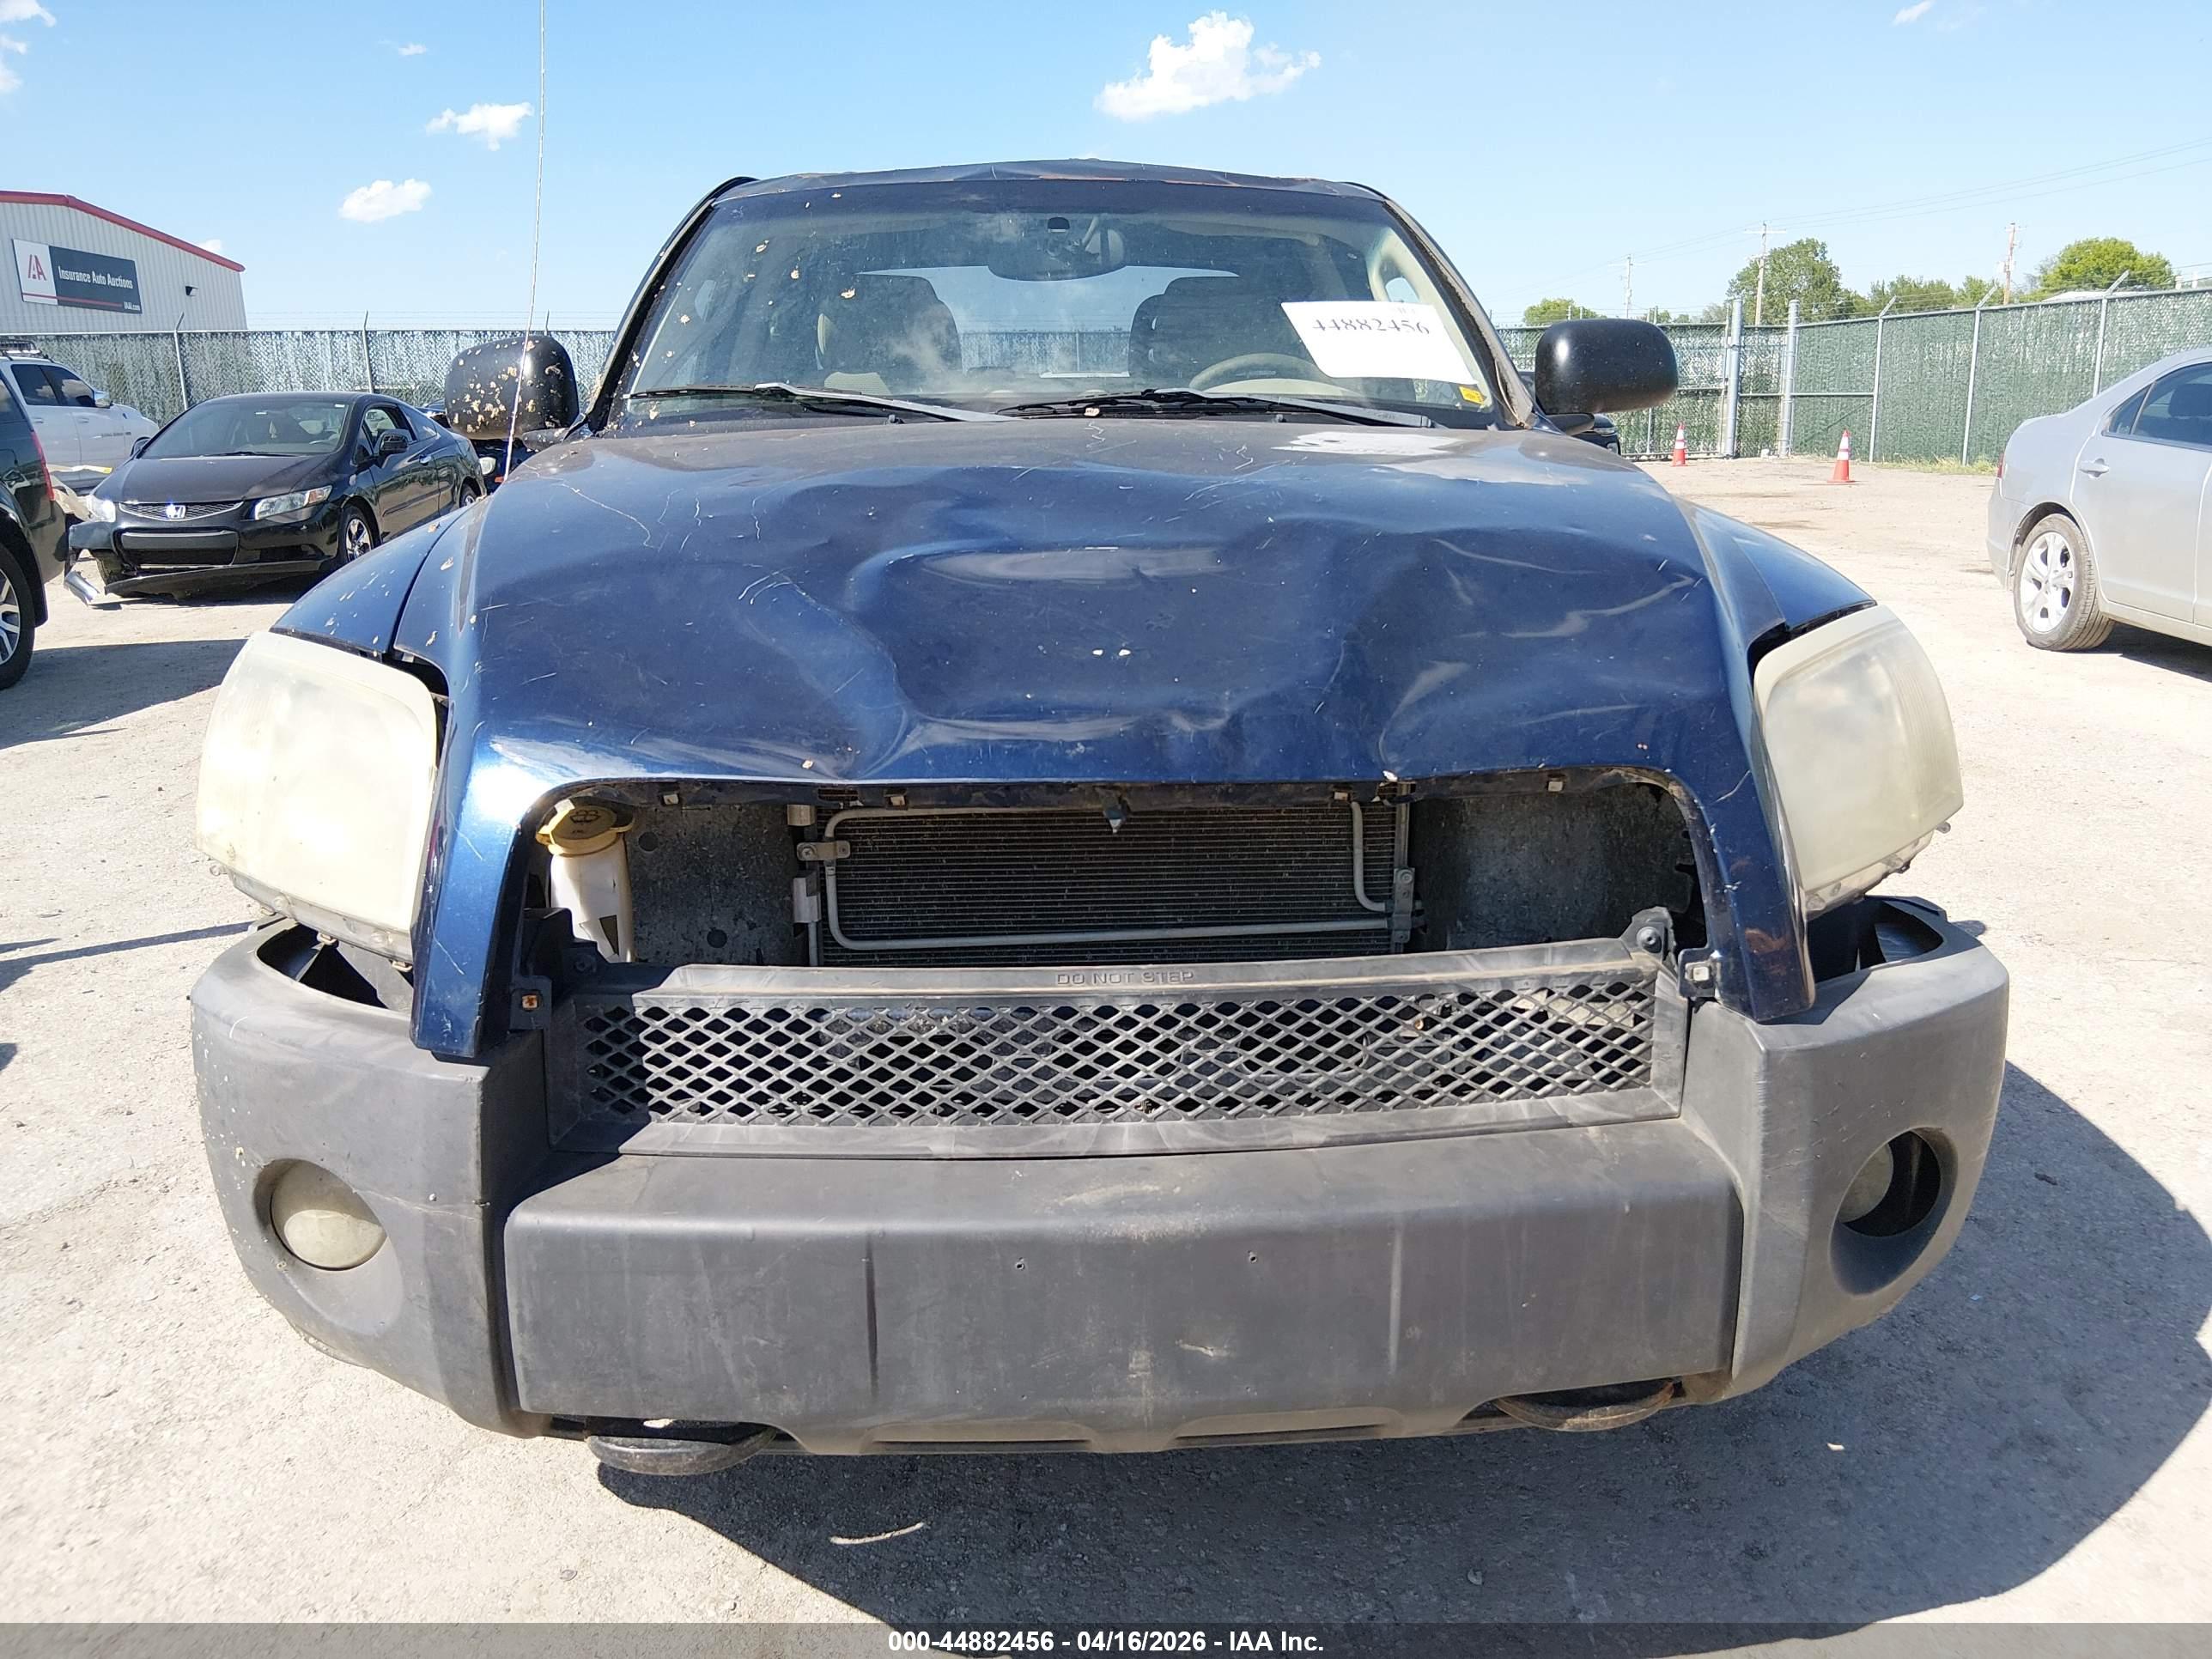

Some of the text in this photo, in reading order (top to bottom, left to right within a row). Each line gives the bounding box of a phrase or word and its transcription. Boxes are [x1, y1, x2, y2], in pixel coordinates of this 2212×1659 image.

[58, 265, 133, 289] Insurance Auto Auctions
[1057, 970, 1194, 985] DO NOT STEP
